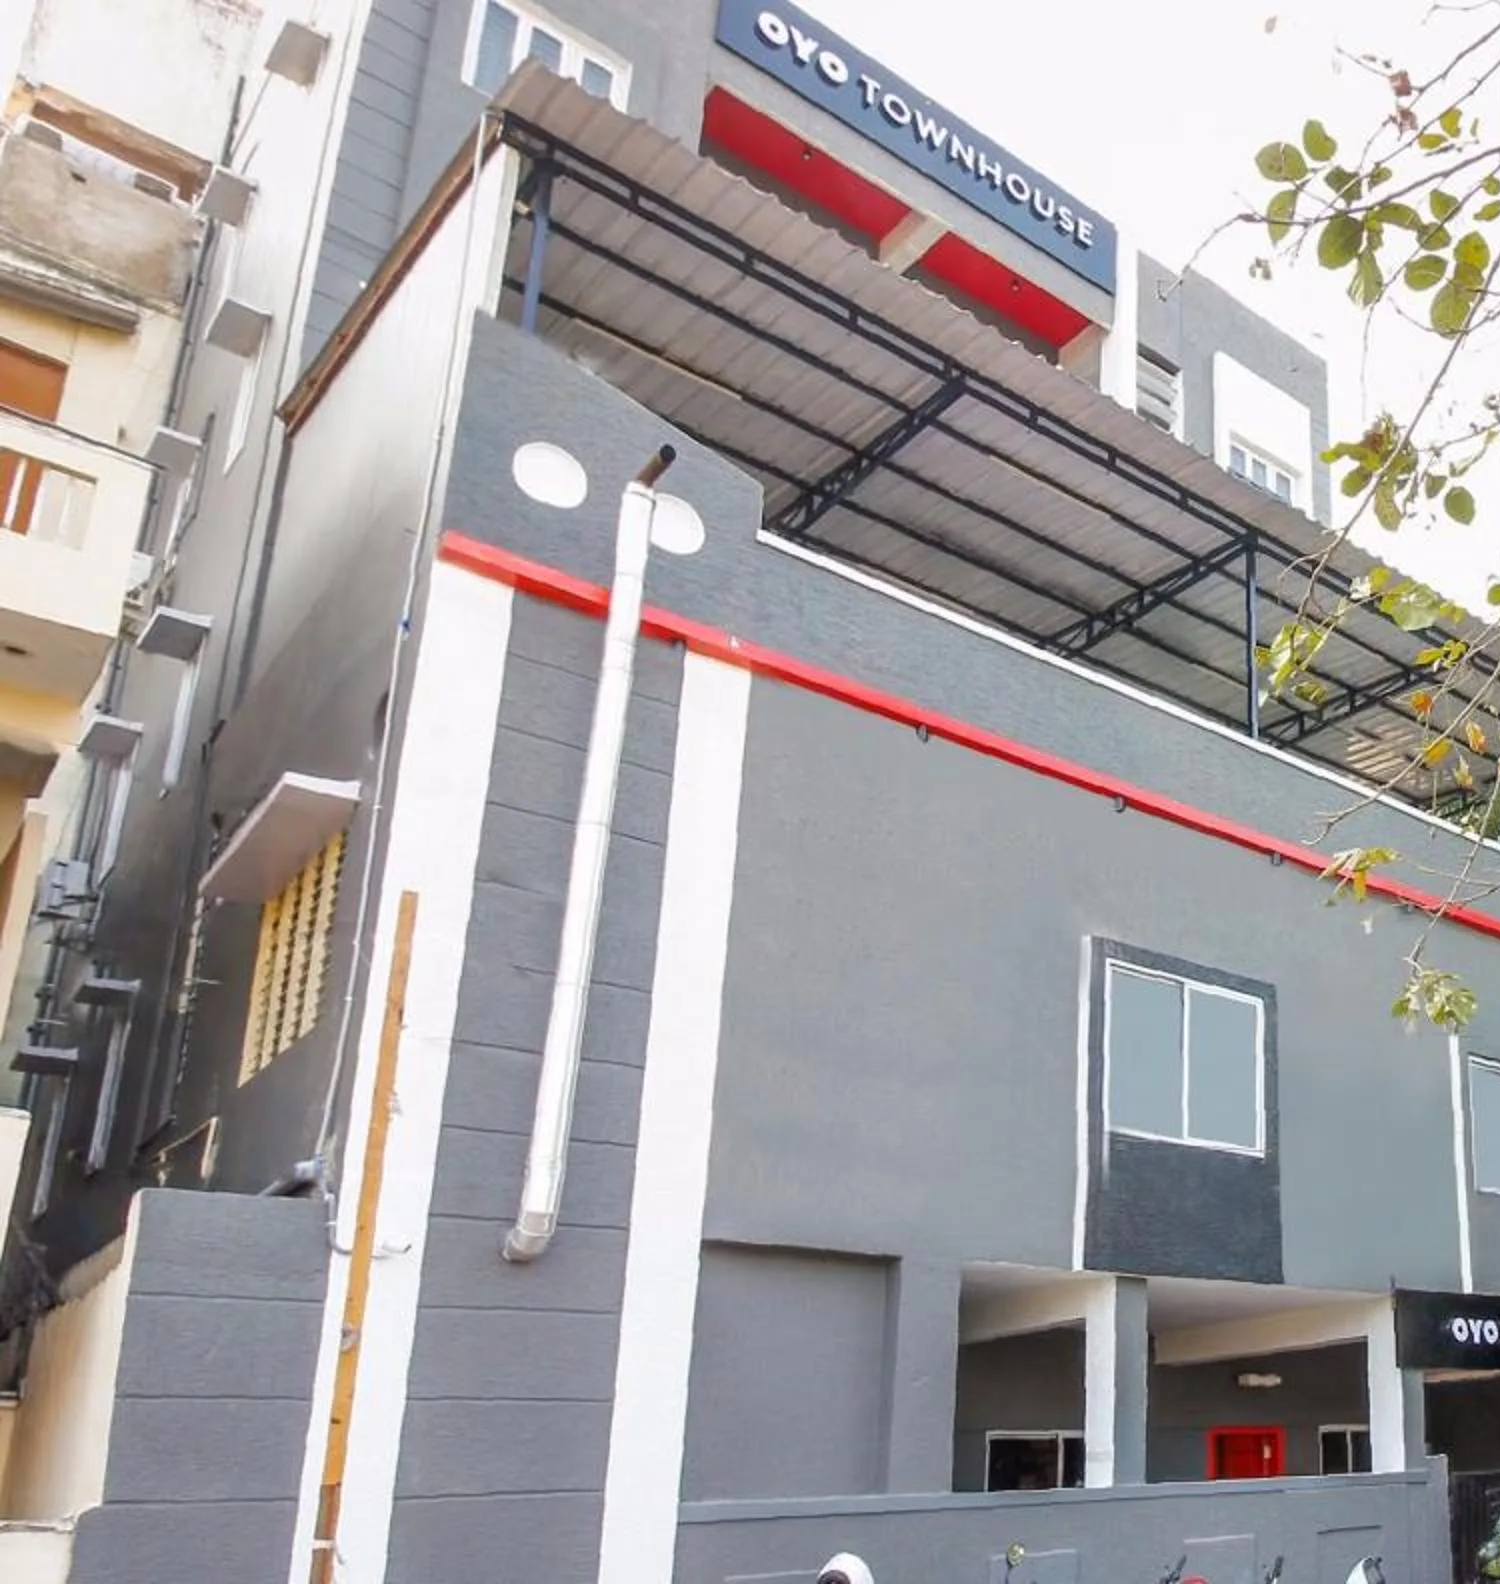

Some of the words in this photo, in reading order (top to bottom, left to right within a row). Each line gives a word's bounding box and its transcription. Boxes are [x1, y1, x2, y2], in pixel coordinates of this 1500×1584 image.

[757, 11, 849, 85] OYO
[858, 74, 1093, 247] TOWNHOUSE
[1452, 1317, 1499, 1344] OYO
